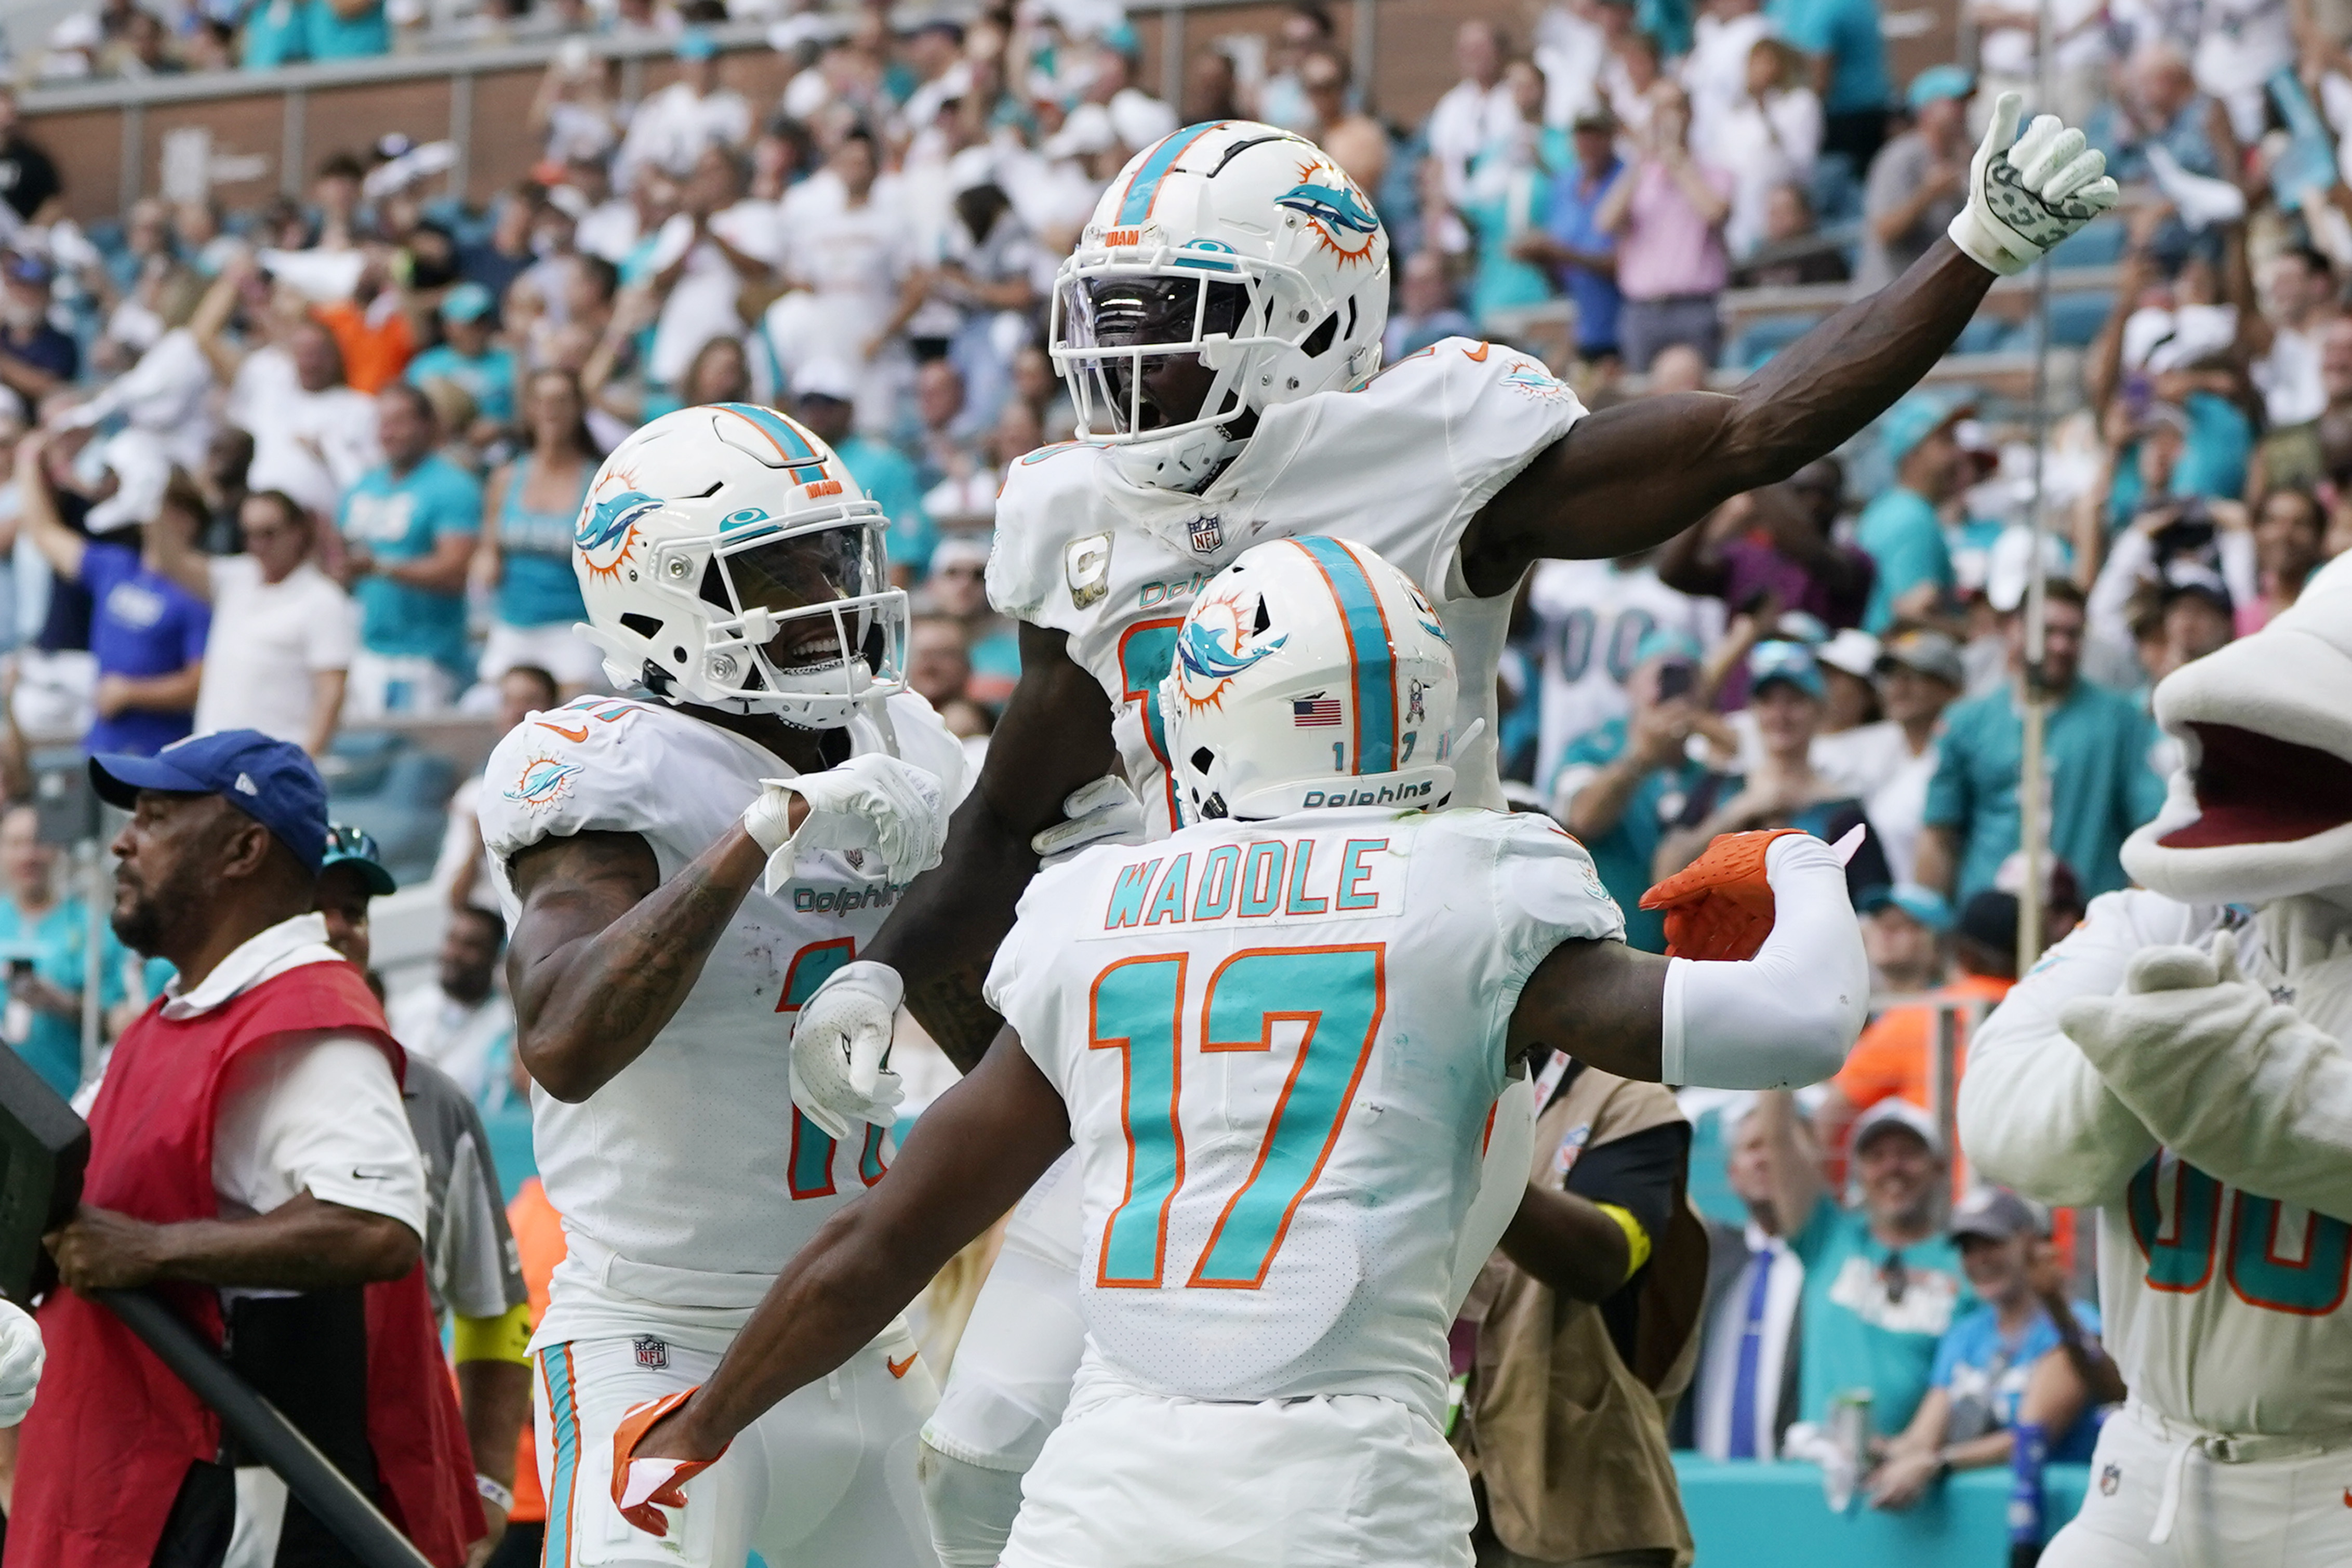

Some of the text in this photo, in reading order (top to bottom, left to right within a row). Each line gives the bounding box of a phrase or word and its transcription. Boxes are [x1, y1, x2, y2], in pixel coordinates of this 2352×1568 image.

[1194, 530, 1220, 550] NFL
[1067, 535, 1108, 591] C
[1302, 780, 1433, 808] Dolphins
[1105, 838, 1389, 929] WADDLE
[1088, 941, 1386, 1289] 17
[639, 1351, 664, 1365] NFL
